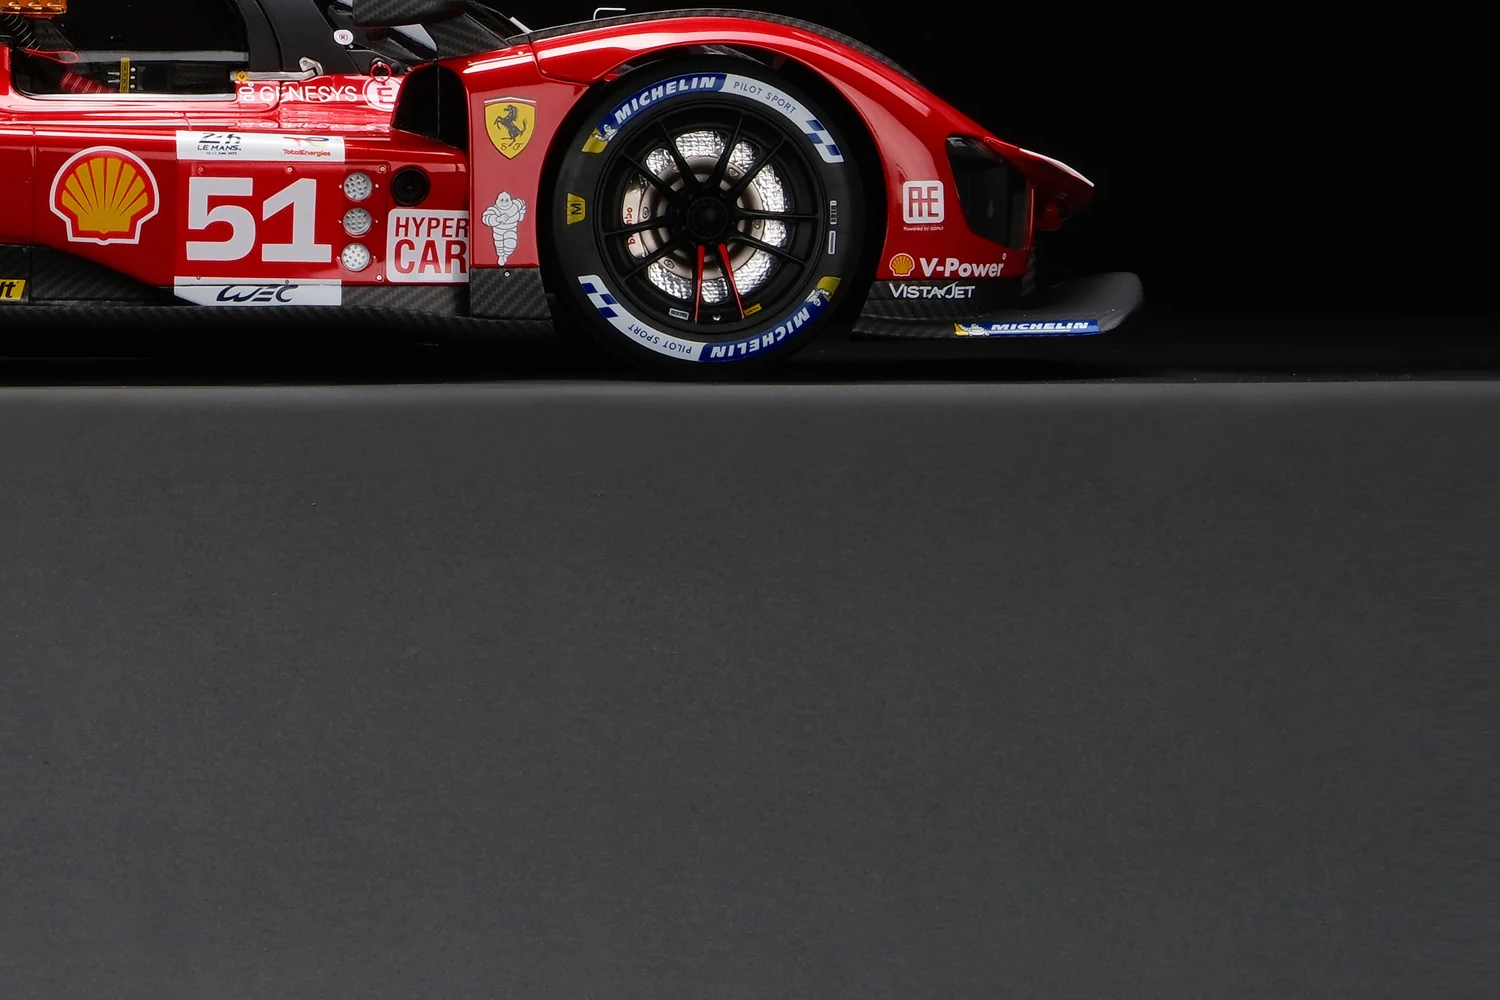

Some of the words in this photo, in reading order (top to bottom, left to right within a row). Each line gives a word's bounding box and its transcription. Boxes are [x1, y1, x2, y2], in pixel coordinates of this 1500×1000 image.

[259, 86, 358, 103] GENESYS
[614, 76, 716, 124] MICHELIN
[733, 81, 762, 96] PILOT
[765, 92, 796, 115] SPORT
[283, 148, 331, 157] TotalEnergies
[185, 176, 333, 263] 51
[395, 216, 469, 238] HYPER
[394, 239, 469, 274] CAR
[919, 257, 1004, 278] V-Power
[216, 284, 299, 303] WEC
[627, 323, 661, 345] SPORT
[709, 307, 811, 358] MICHELIN
[990, 322, 1089, 331] MICHELIN
[662, 341, 692, 354] PILOT
